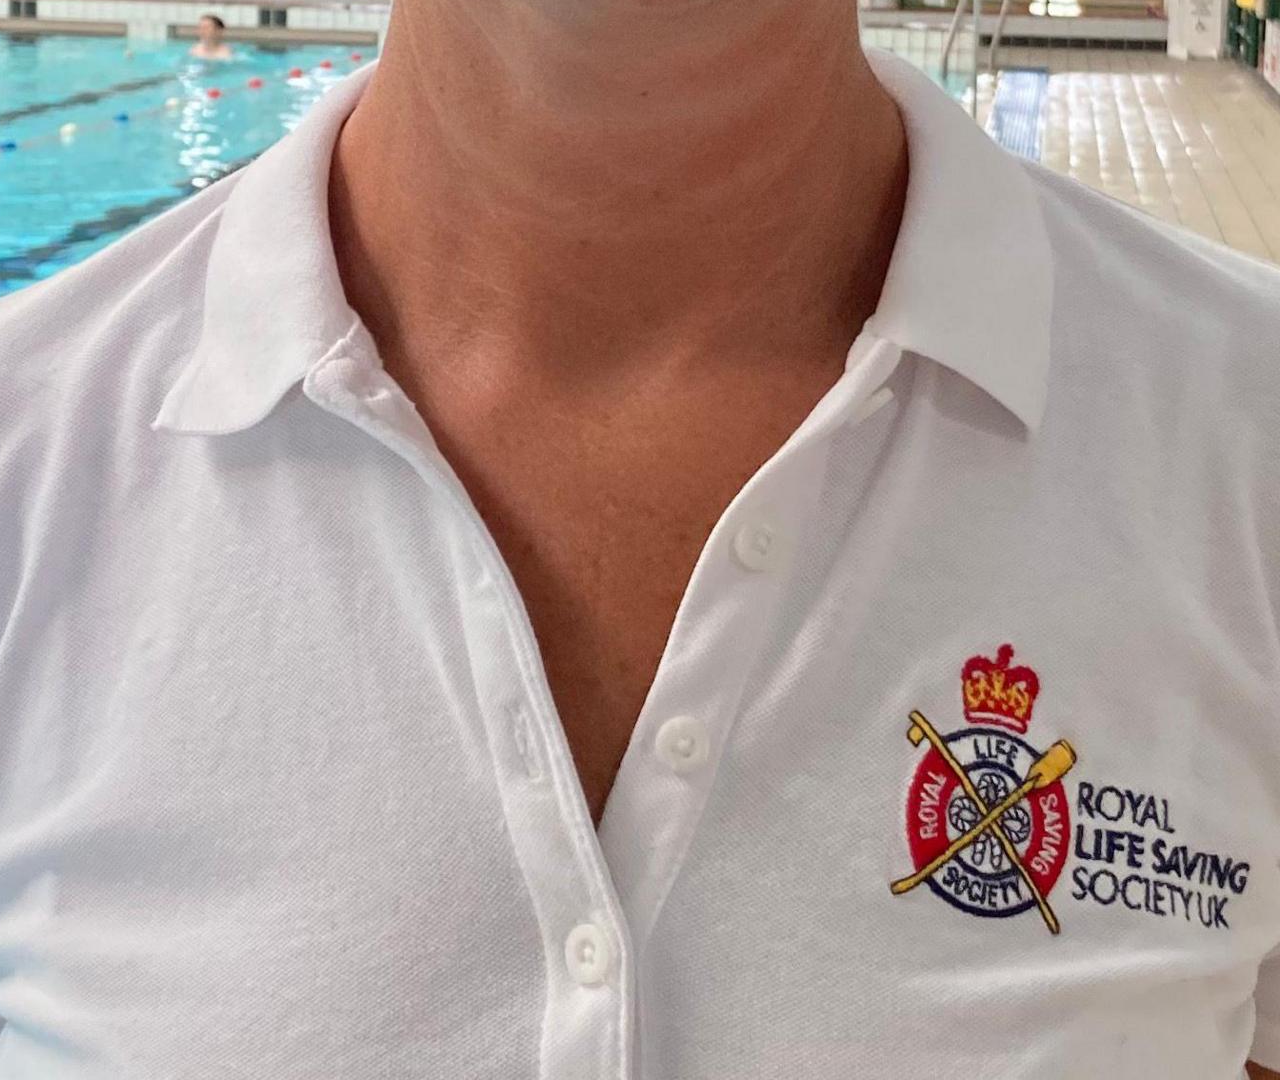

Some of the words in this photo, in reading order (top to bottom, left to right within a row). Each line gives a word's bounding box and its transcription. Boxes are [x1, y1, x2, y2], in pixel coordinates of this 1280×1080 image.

[974, 738, 1018, 768] LIFE
[918, 772, 947, 840] ROYAL
[1030, 793, 1063, 876] SAVING
[1078, 781, 1176, 834] ROYAL
[942, 866, 1023, 908] SOCIETY
[1074, 824, 1145, 868] LIFE
[1151, 838, 1250, 894] SAVING
[1072, 866, 1193, 921] SOCIETY
[1197, 891, 1229, 929] UK
